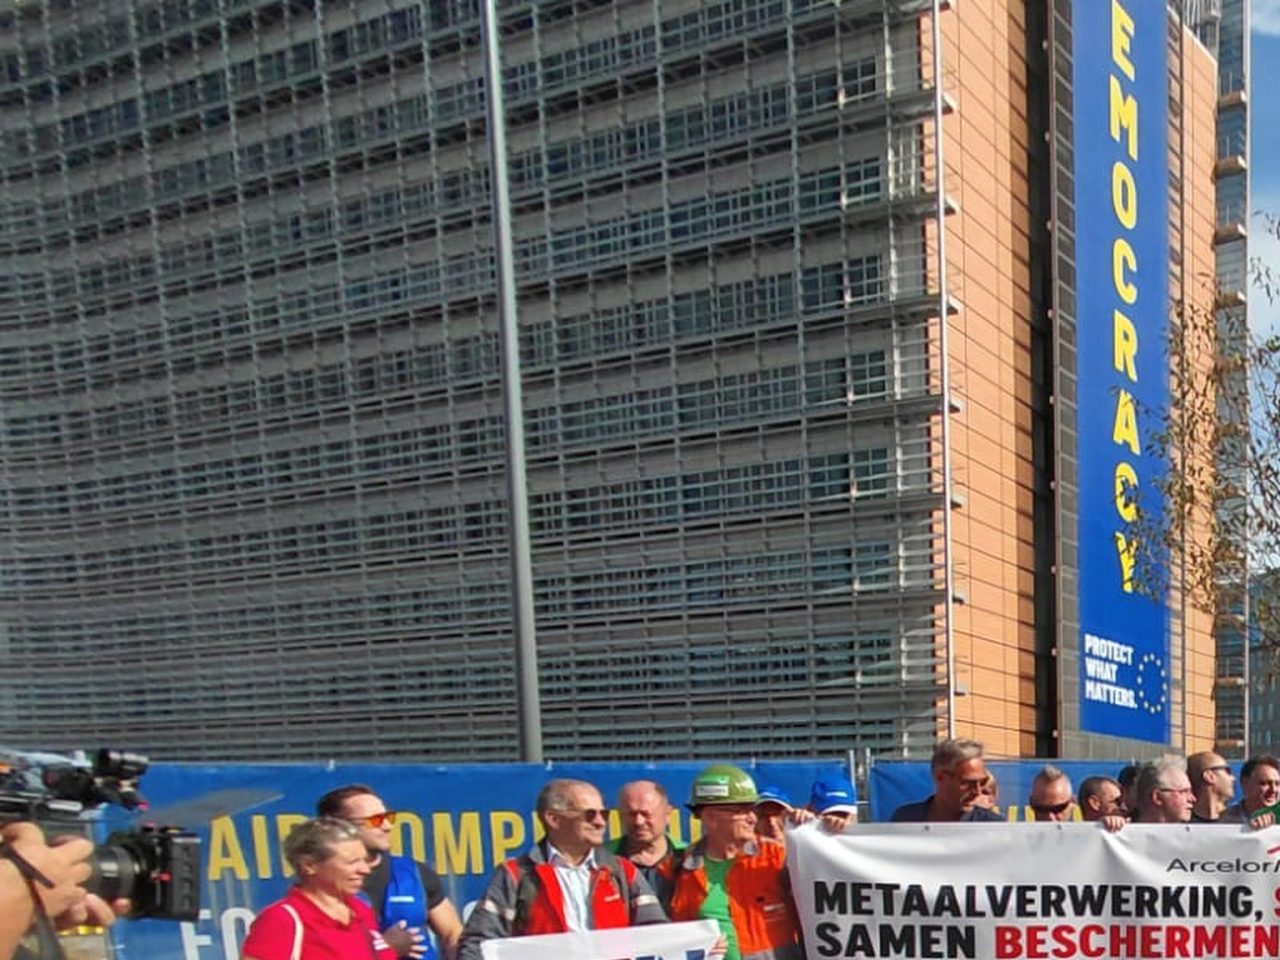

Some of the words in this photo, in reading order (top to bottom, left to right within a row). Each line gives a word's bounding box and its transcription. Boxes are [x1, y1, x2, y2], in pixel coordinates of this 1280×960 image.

[1084, 633, 1134, 666] PROTECT
[1085, 656, 1119, 683] WHAT
[1085, 679, 1138, 709] MATTERS.
[813, 880, 1263, 922] METAALVERWERKING,
[814, 921, 977, 960] SAMEN
[994, 924, 1280, 960] BESCHERMEN
